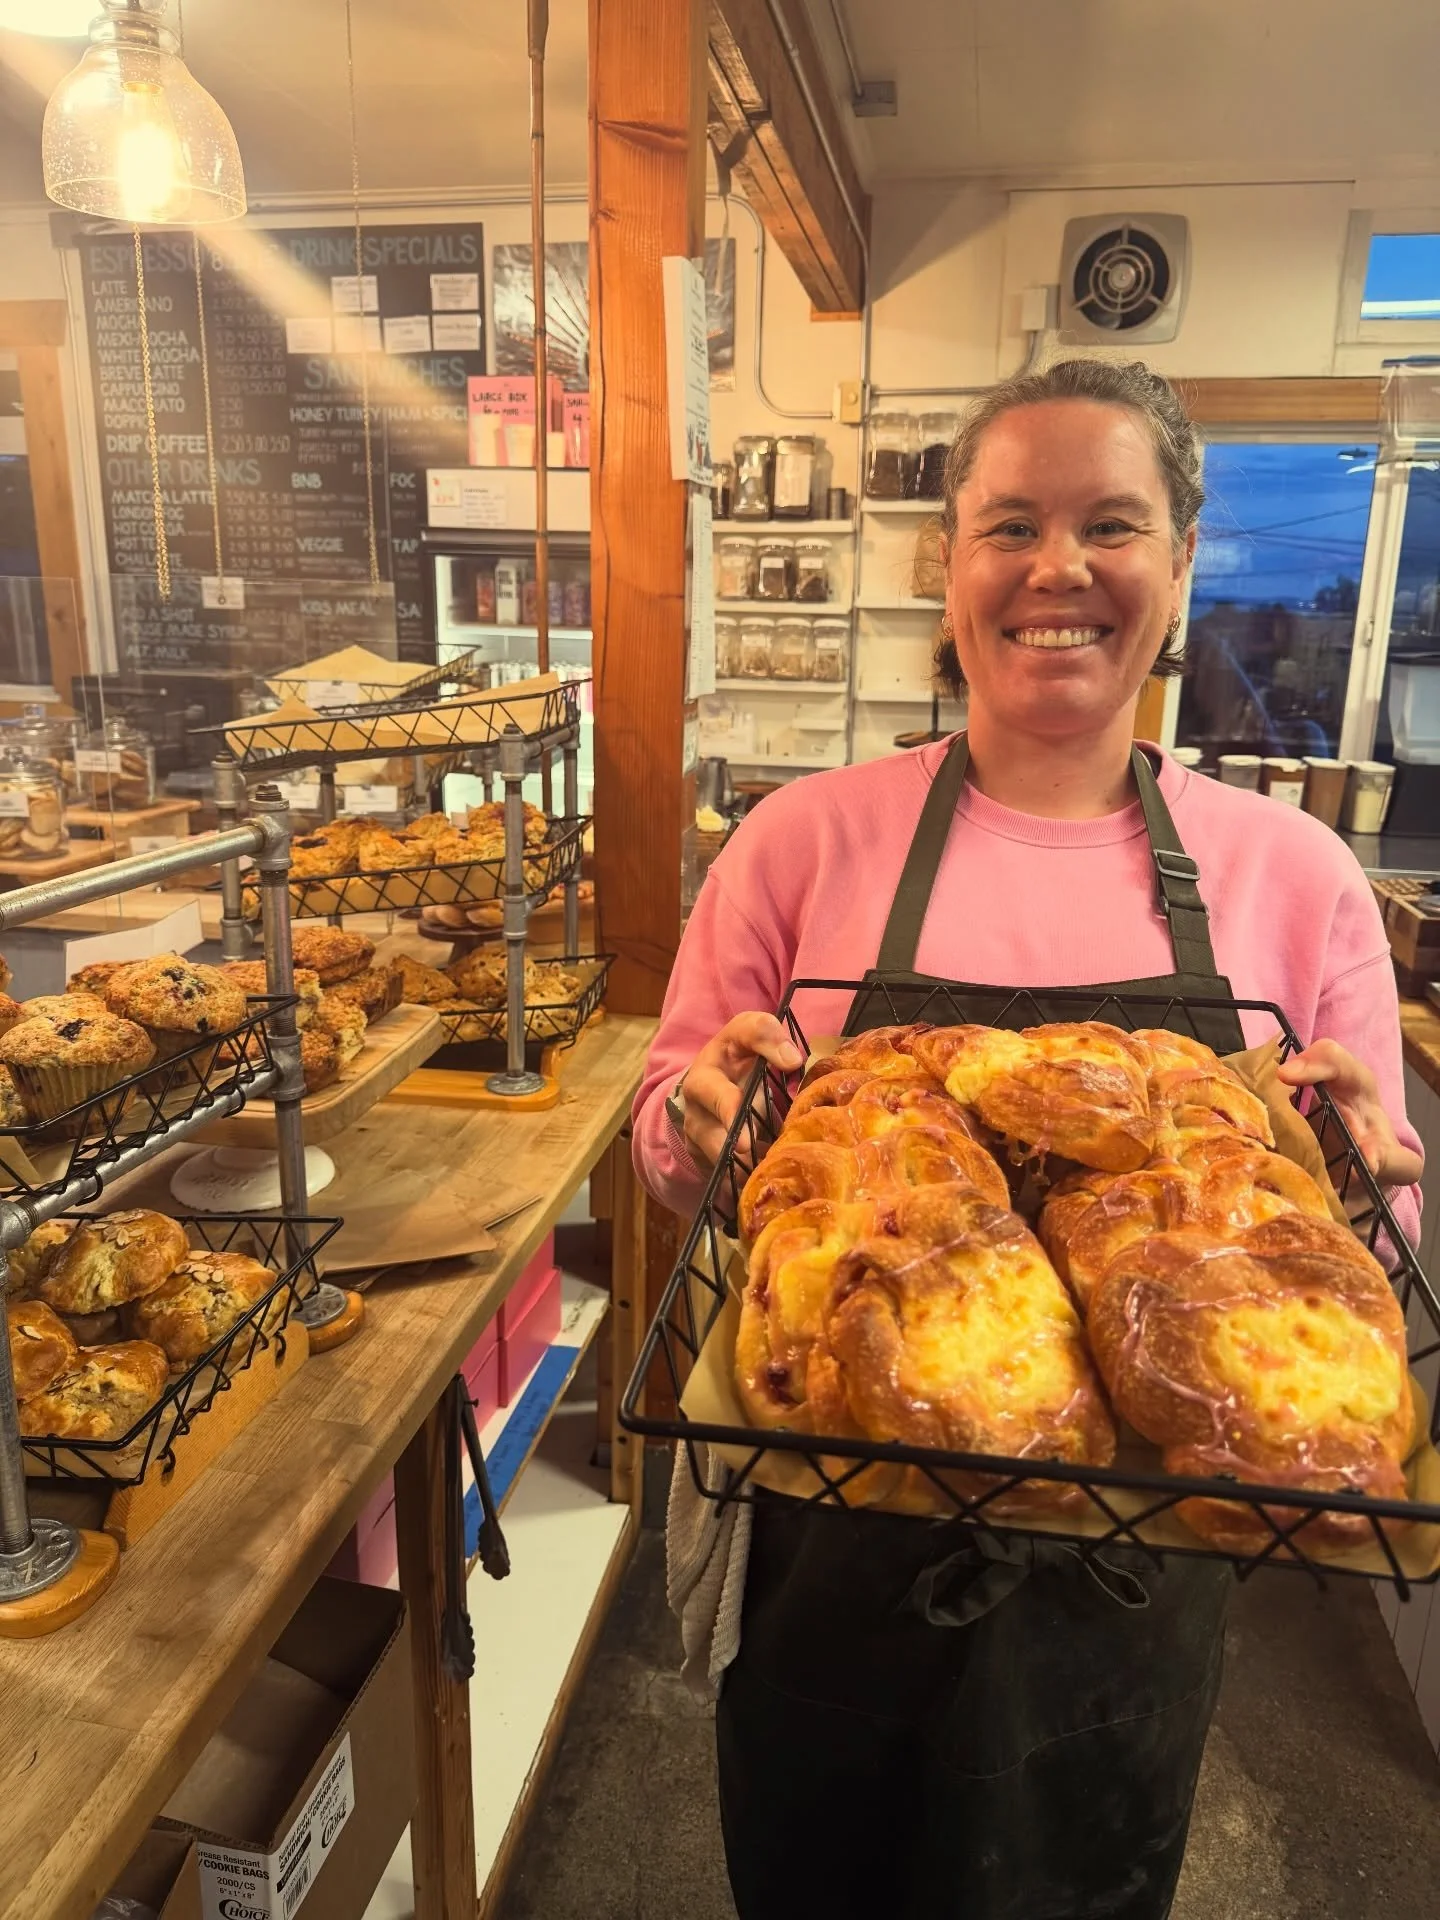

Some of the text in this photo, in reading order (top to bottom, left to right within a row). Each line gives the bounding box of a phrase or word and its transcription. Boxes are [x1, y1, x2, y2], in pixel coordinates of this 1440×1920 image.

[363, 233, 478, 267] SPECIALS
[92, 280, 129, 296] LATTE
[147, 363, 185, 381] ATTE
[289, 405, 381, 423] HONEY TURKY
[106, 435, 142, 453] DRIP
[106, 457, 262, 486] OTHR DRNKS
[111, 489, 169, 505] MATCA
[113, 521, 136, 536] HOT
[139, 521, 186, 537] COOA
[115, 536, 137, 551] HOT
[334, 600, 377, 617] MEAL
[331, 1755, 346, 1784] BAGS
[223, 1854, 261, 1868] Resistant
[242, 1866, 270, 1880] BAGS
[216, 1876, 256, 1891] 2000/CS
[218, 1898, 271, 1920] CHOICE
